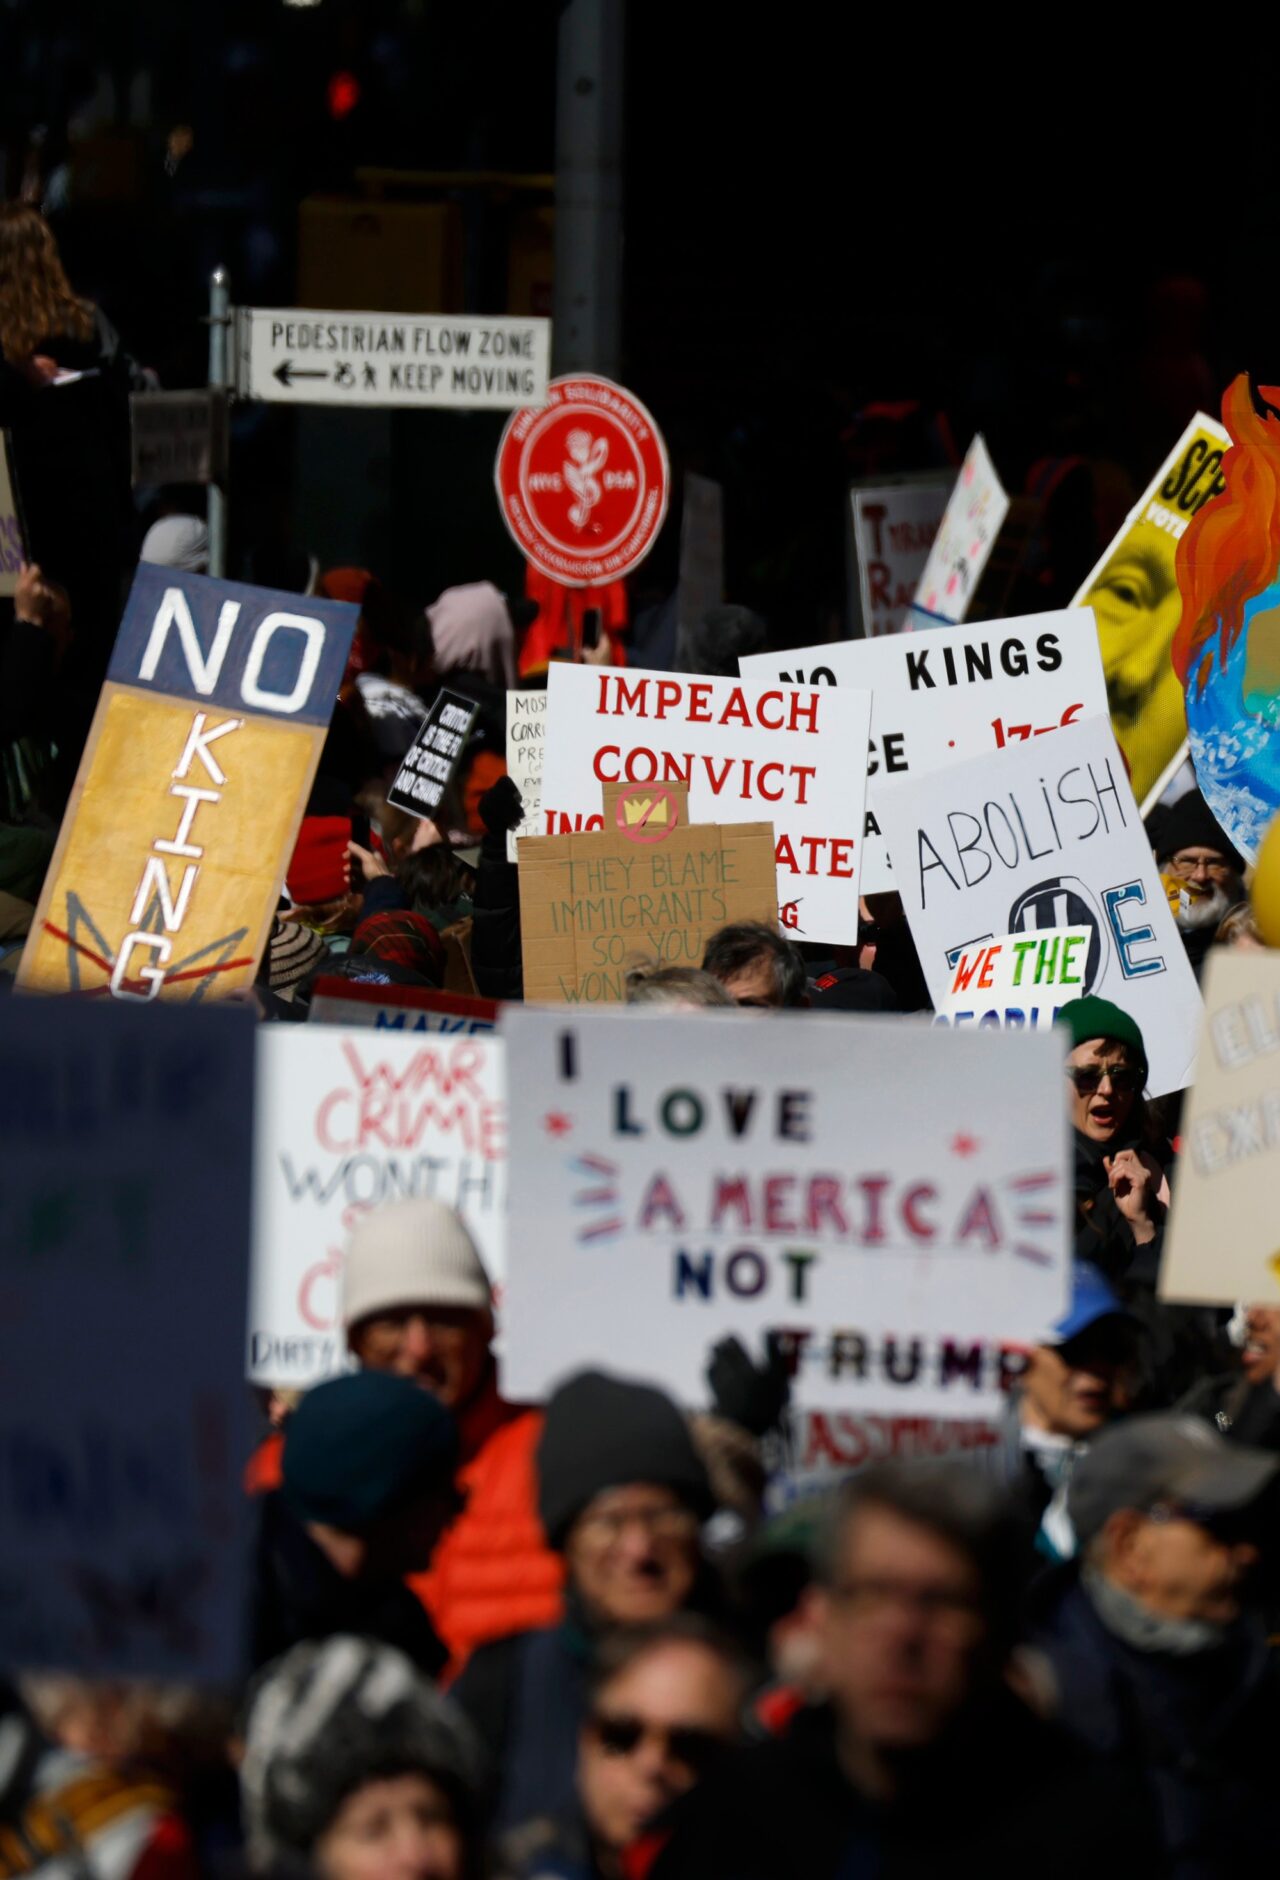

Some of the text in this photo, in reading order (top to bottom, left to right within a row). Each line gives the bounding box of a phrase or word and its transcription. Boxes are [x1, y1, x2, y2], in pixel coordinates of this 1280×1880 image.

[272, 322, 536, 360] PEDESTRIAN FLOW ZONE
[390, 362, 535, 395] KEEP MOVING
[602, 469, 636, 490] DSA
[139, 588, 326, 713] NO
[906, 633, 1063, 690] KINGS
[595, 675, 820, 734] IMPEACH
[517, 746, 544, 764] PRE
[593, 745, 816, 804] CONVICT
[111, 712, 247, 1001] KING
[559, 849, 741, 894] THEY BLAME
[552, 888, 728, 934] IMMIGRANTS
[592, 926, 701, 968] SO YOU
[952, 936, 1086, 995] WE THE
[558, 970, 627, 1005] WON
[342, 1036, 485, 1099] WAR
[558, 1030, 580, 1081] I
[612, 1085, 815, 1143] LOVE
[638, 1170, 1004, 1249] AMERICA
[674, 1247, 818, 1302] NOT
[778, 1325, 1033, 1394] TRUMP
